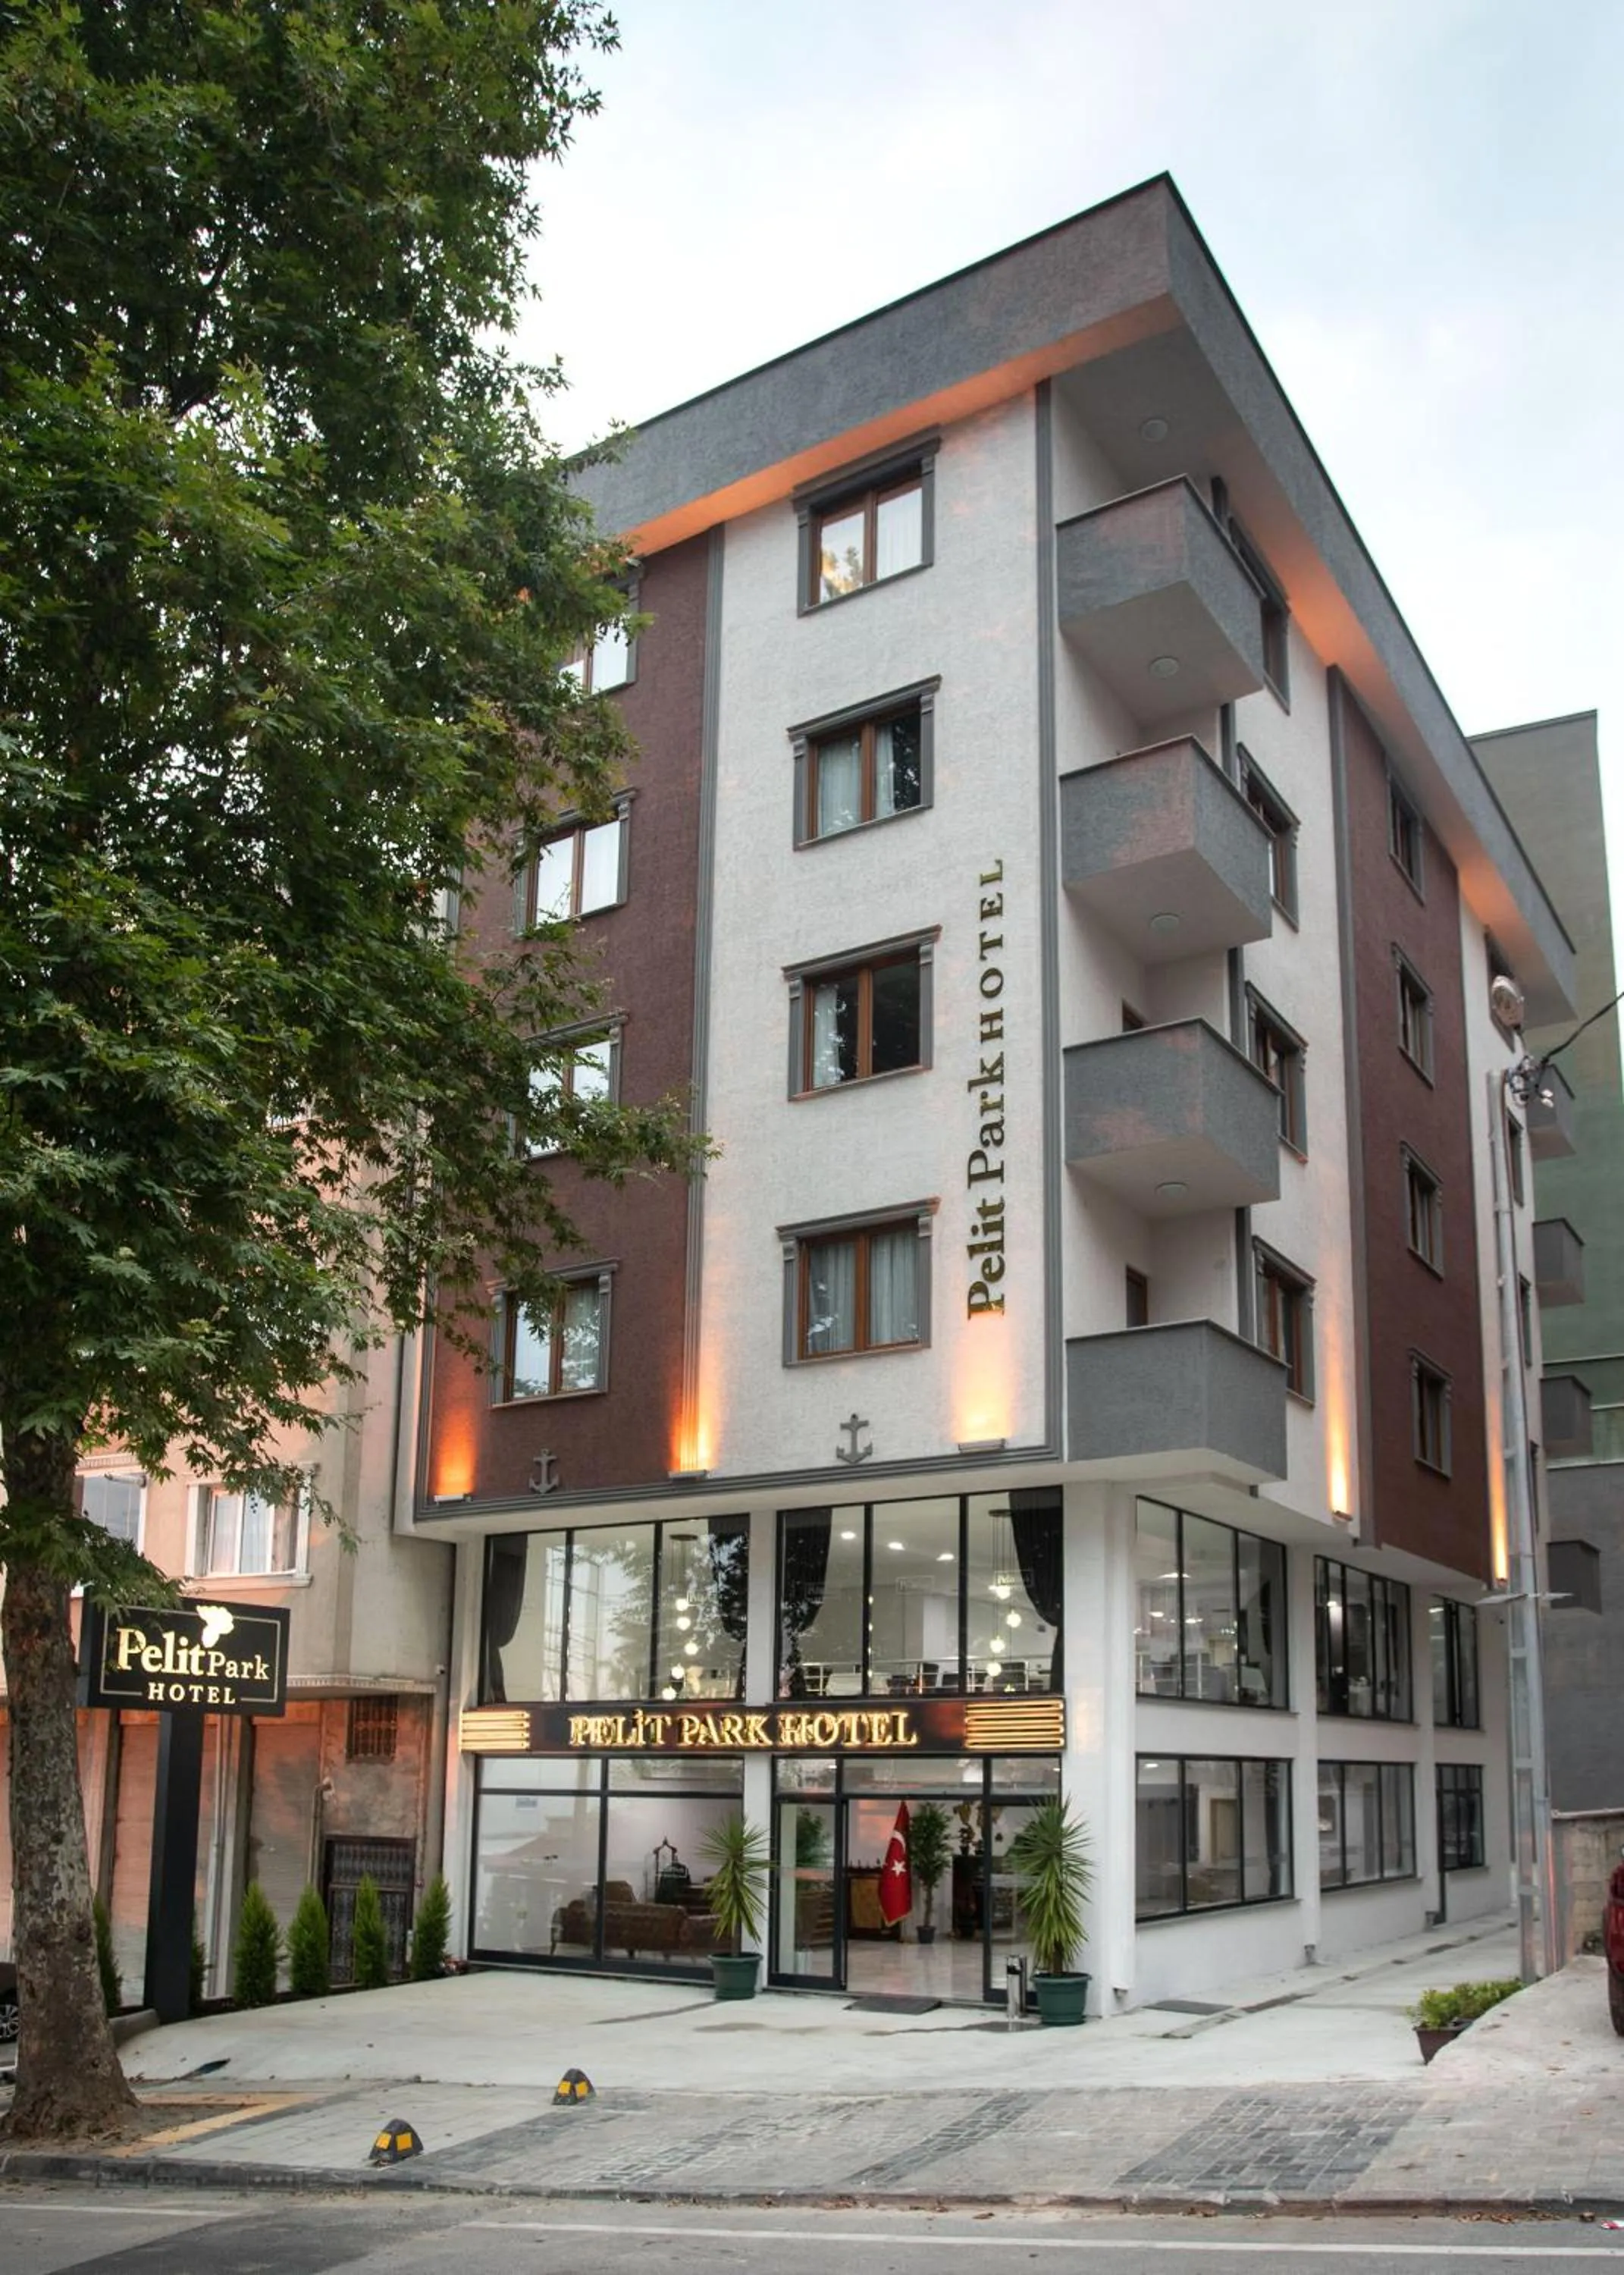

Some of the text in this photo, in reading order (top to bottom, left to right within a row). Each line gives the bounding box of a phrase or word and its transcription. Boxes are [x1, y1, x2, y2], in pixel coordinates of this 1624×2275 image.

[979, 858, 1005, 1044] HOTEL
[148, 1681, 236, 1705] HOTEL
[676, 1712, 773, 1746] PARK
[778, 1711, 919, 1747] HOTEL
